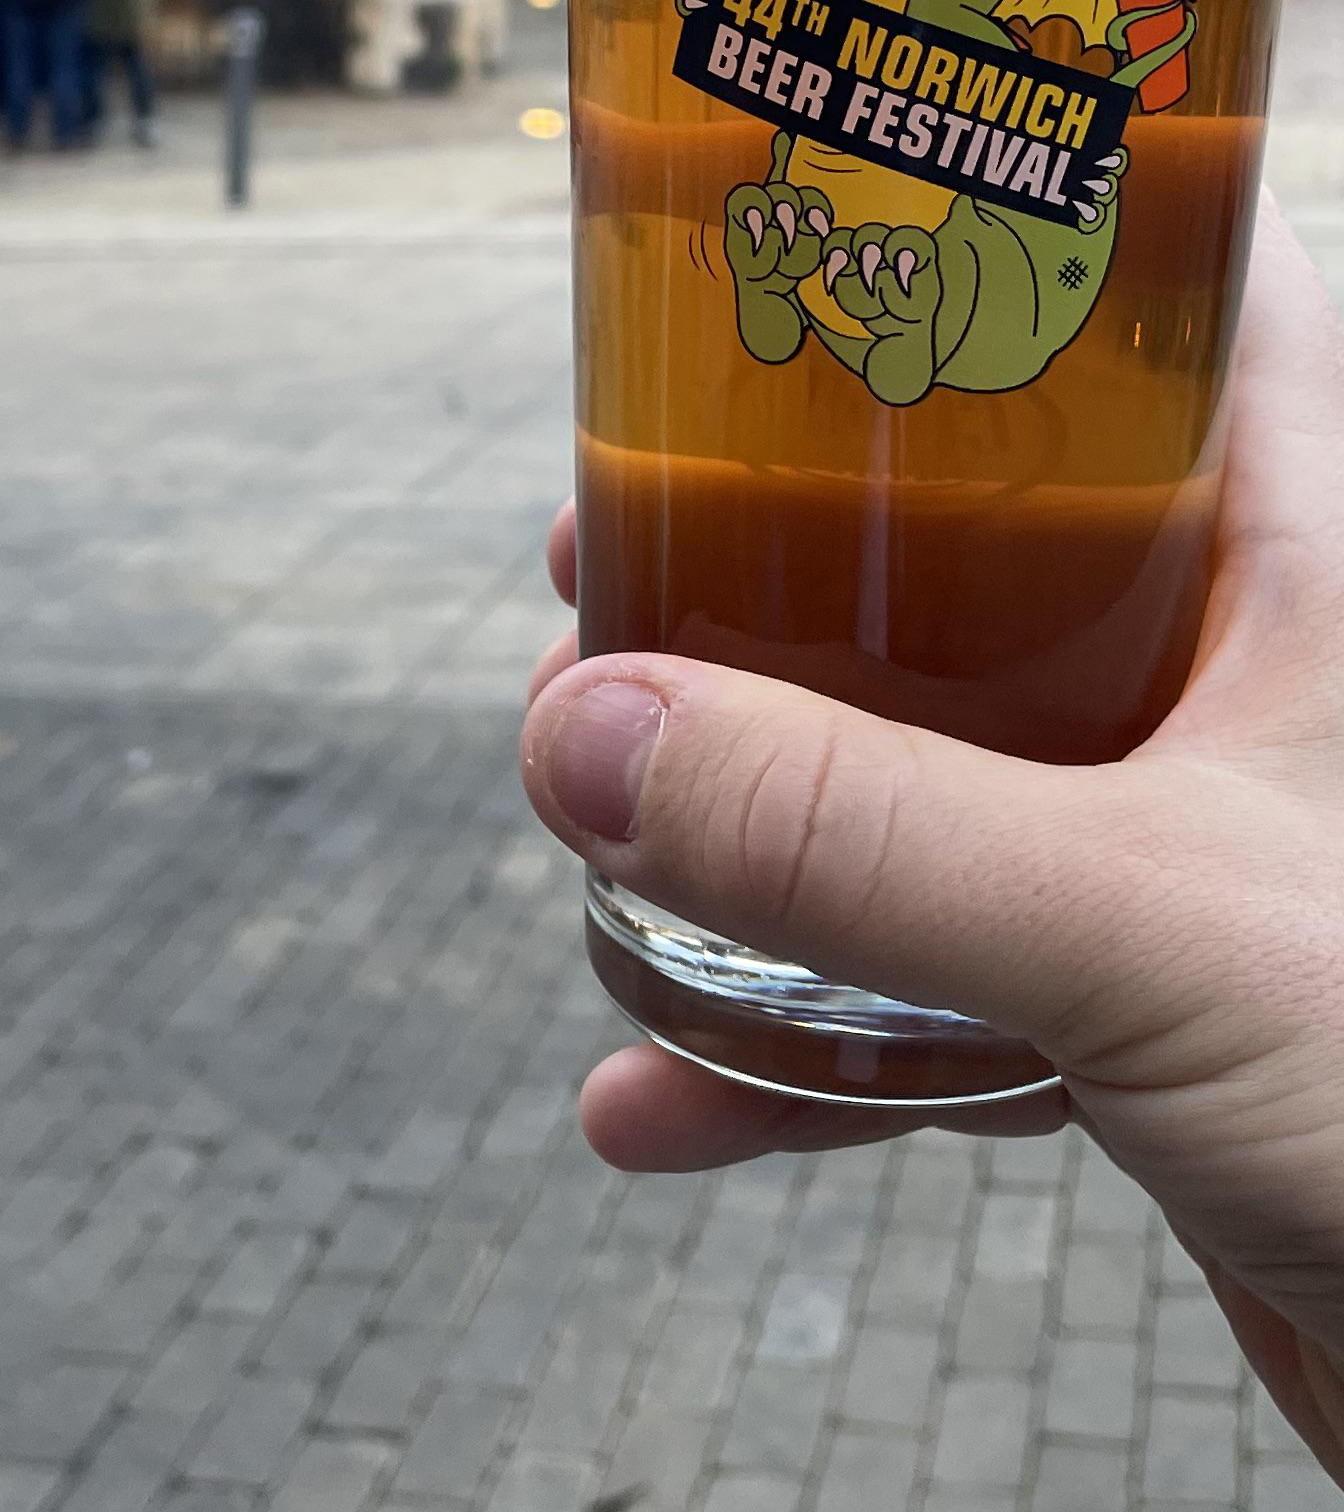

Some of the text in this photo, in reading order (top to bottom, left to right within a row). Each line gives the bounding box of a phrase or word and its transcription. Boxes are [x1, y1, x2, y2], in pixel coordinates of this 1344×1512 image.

[706, 23, 1072, 206] BEER FESTIVAL
[836, 17, 1098, 150] NORWICH
